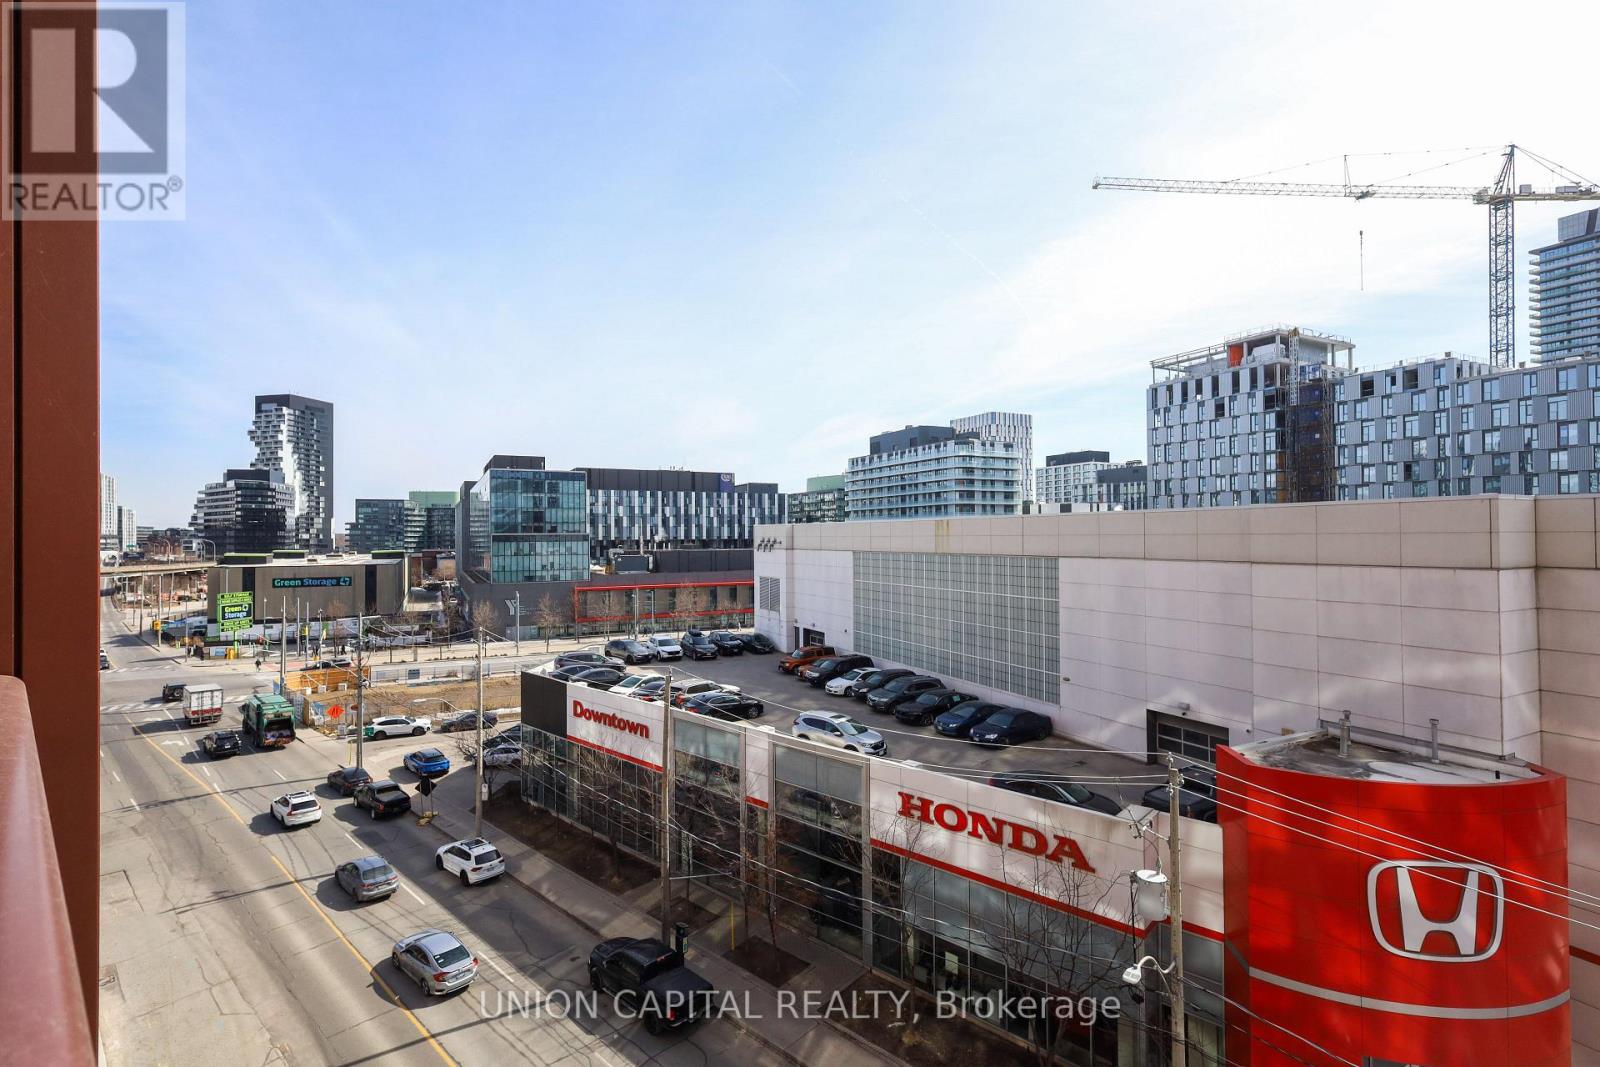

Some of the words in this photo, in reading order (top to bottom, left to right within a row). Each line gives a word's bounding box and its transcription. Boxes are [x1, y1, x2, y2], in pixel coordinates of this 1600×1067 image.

[303, 578, 336, 586] Storage
[224, 611, 247, 619] Storage
[572, 699, 650, 739] Downtown
[897, 791, 1096, 874] HONDA
